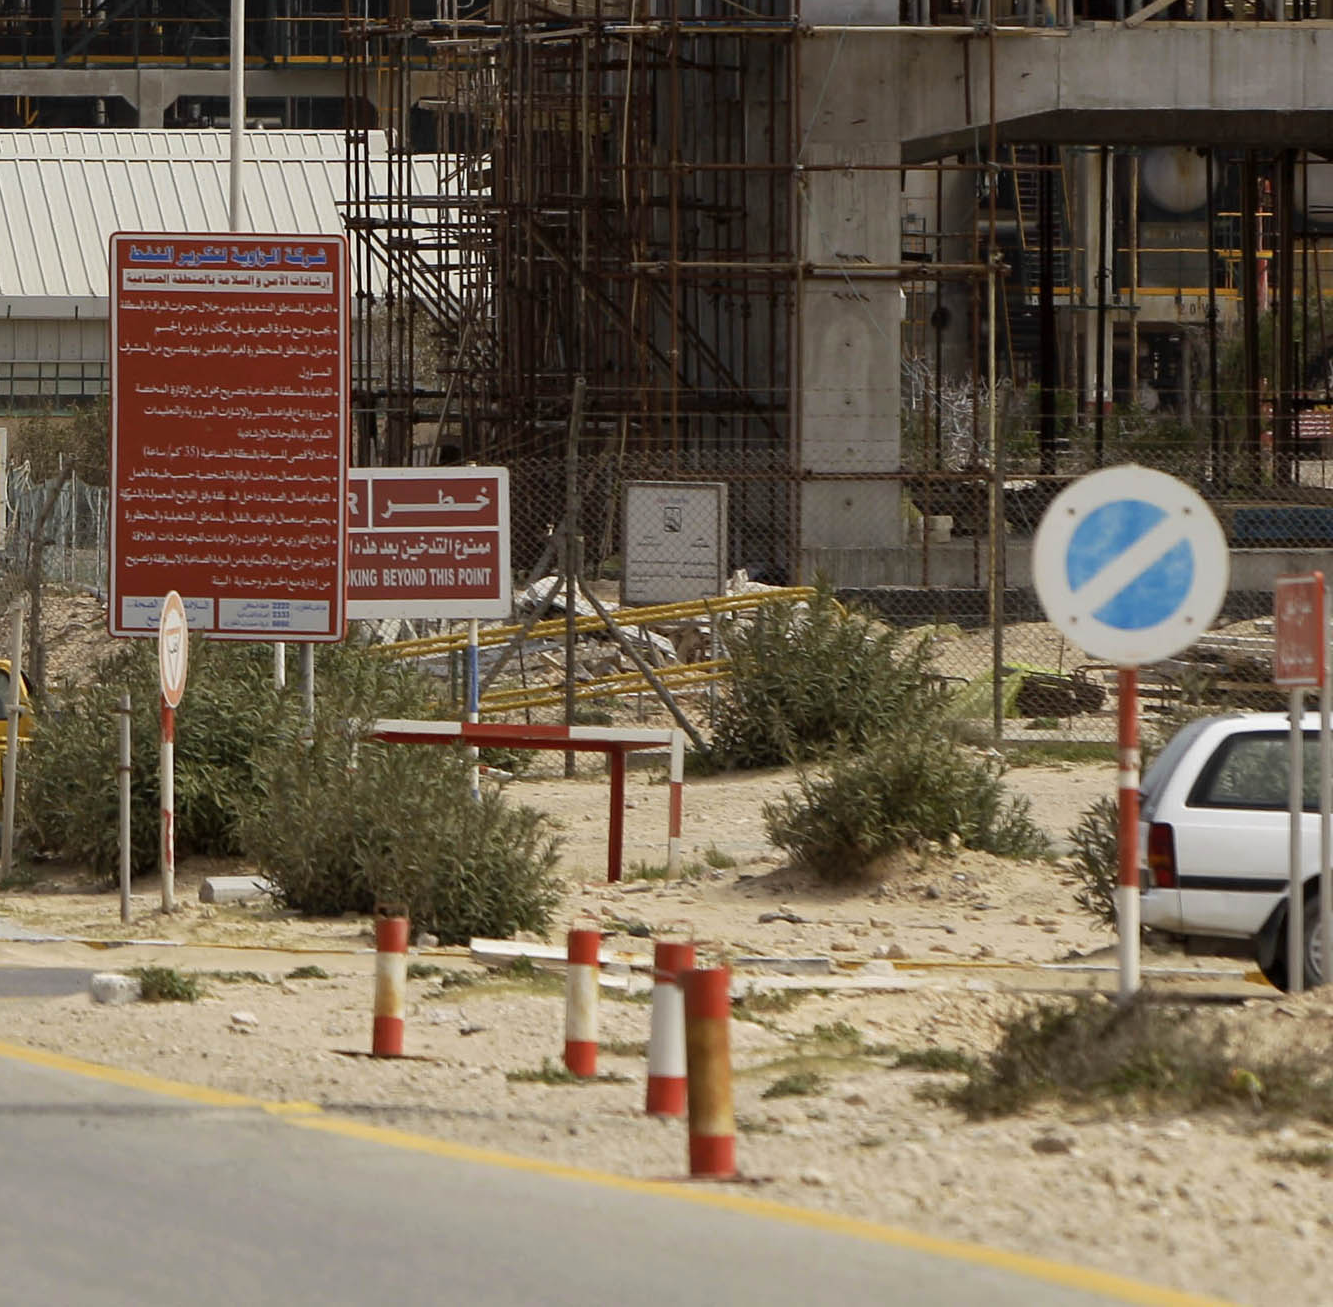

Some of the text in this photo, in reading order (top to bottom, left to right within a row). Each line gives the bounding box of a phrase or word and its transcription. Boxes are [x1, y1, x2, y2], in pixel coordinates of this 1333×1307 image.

[129, 245, 327, 268] شركة الزاوية لتكرير النفط
[380, 486, 490, 519] خطر
[380, 540, 400, 560] بعد
[401, 536, 452, 561] التدخين
[454, 538, 491, 561] ممنوع
[383, 568, 427, 586] BEYOND
[429, 568, 456, 585] THIS
[458, 568, 492, 586] POINT
